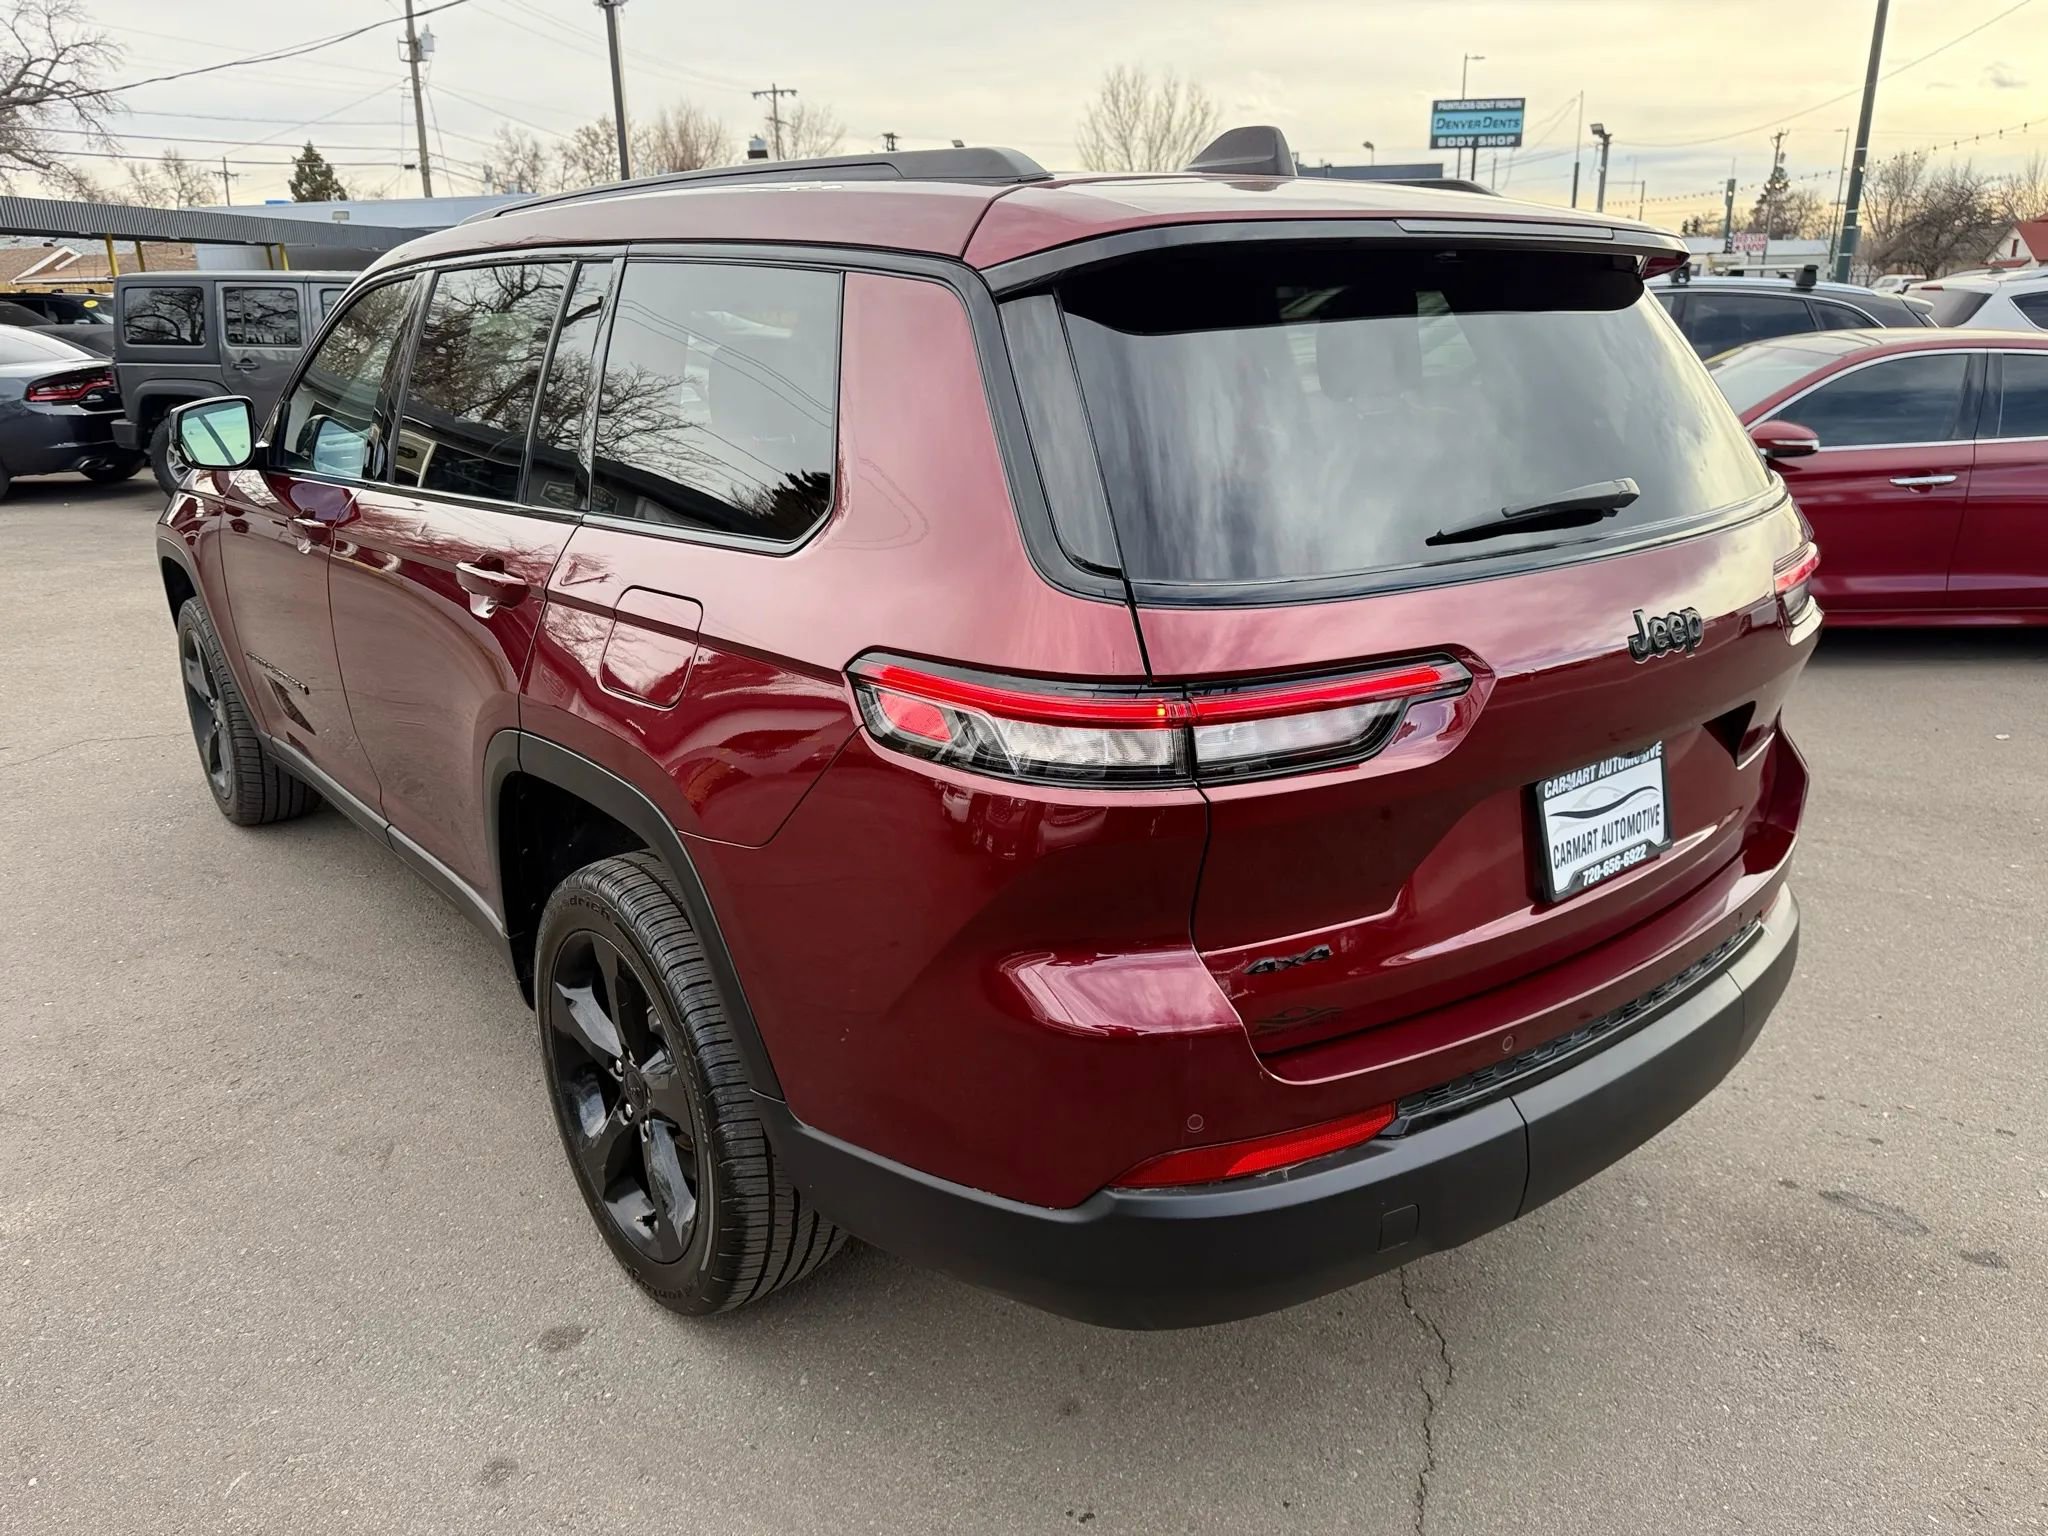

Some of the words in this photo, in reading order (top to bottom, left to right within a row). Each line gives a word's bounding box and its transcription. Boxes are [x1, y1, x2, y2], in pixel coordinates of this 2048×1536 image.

[1437, 136, 1475, 147] BODY
[1477, 135, 1516, 146] SHOP
[1628, 607, 1703, 660] Jeep
[1544, 764, 1597, 799] CARMART
[1553, 828, 1598, 869] CARMART
[1601, 803, 1660, 849] AUTOMOTIVE
[1582, 843, 1647, 887] 720-656-6922
